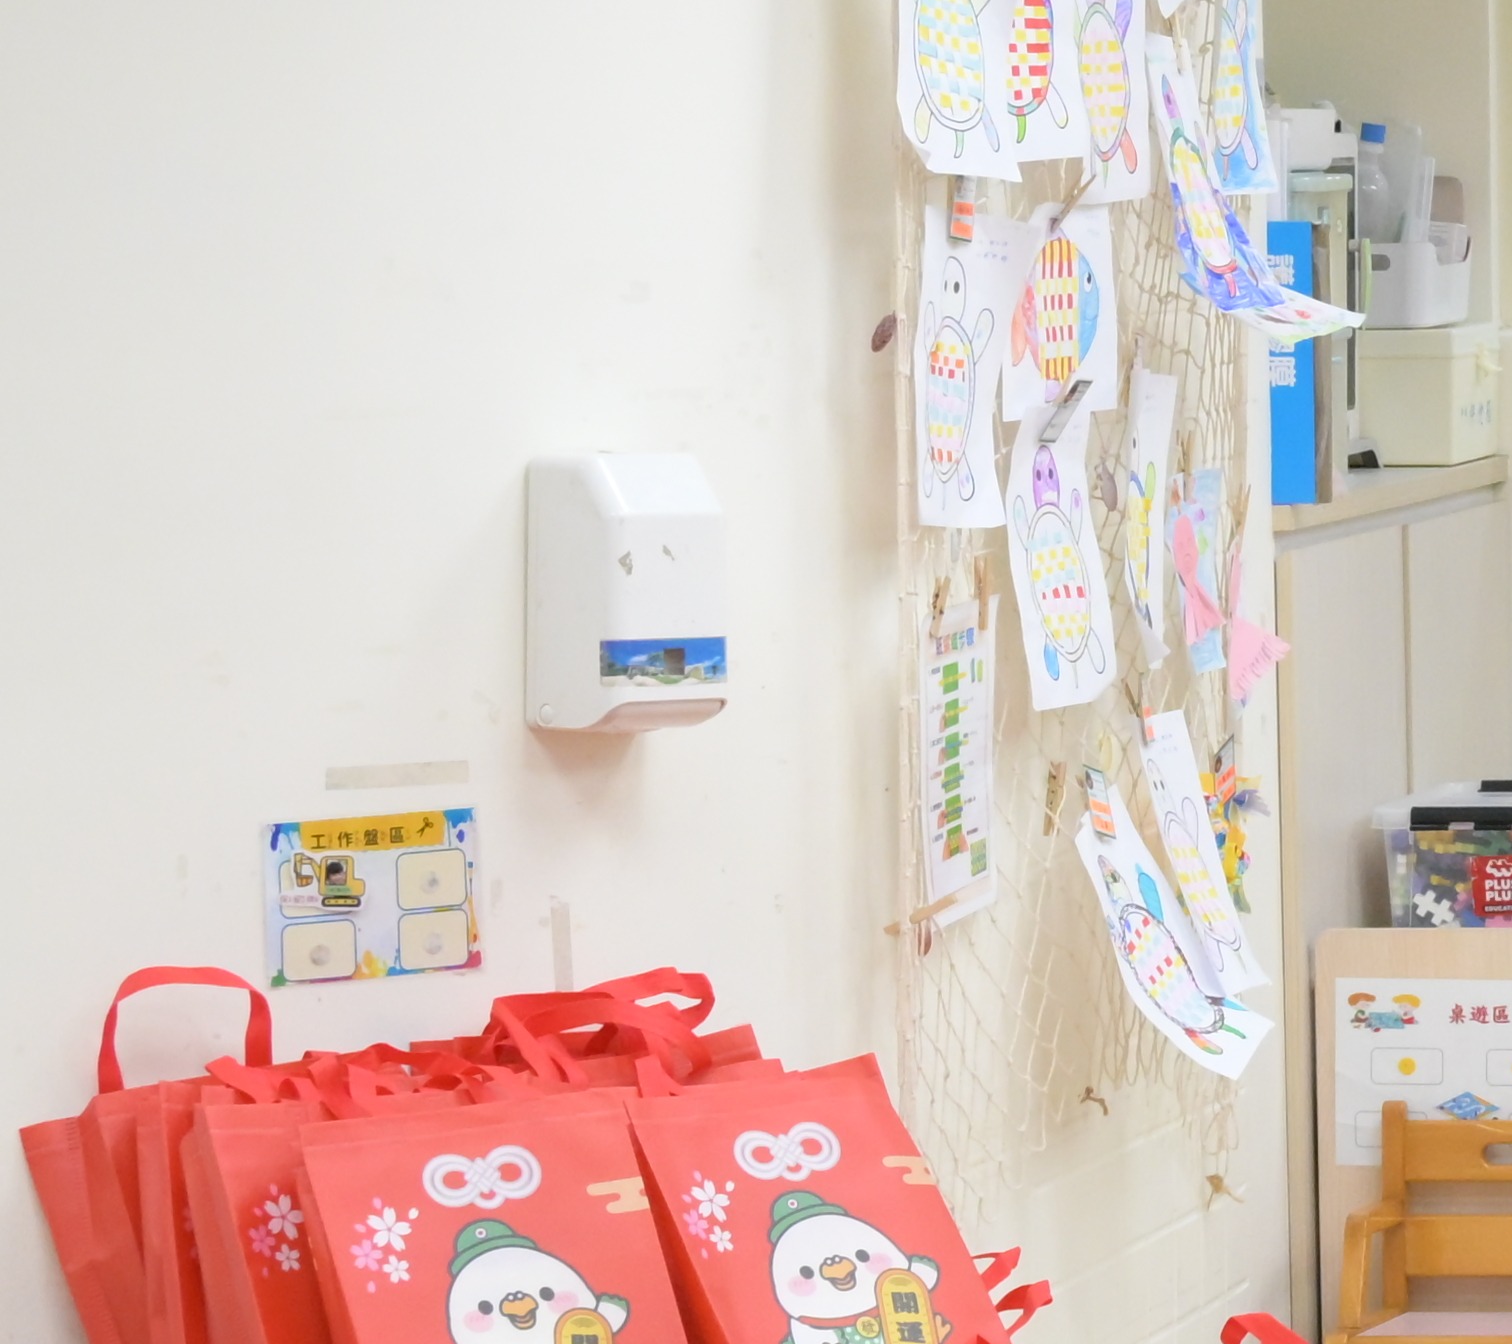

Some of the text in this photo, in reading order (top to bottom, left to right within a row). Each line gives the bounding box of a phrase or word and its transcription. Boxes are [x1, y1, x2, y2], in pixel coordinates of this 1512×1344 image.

[310, 826, 405, 850] 工作盤區
[1447, 1003, 1511, 1026] 桌遊區
